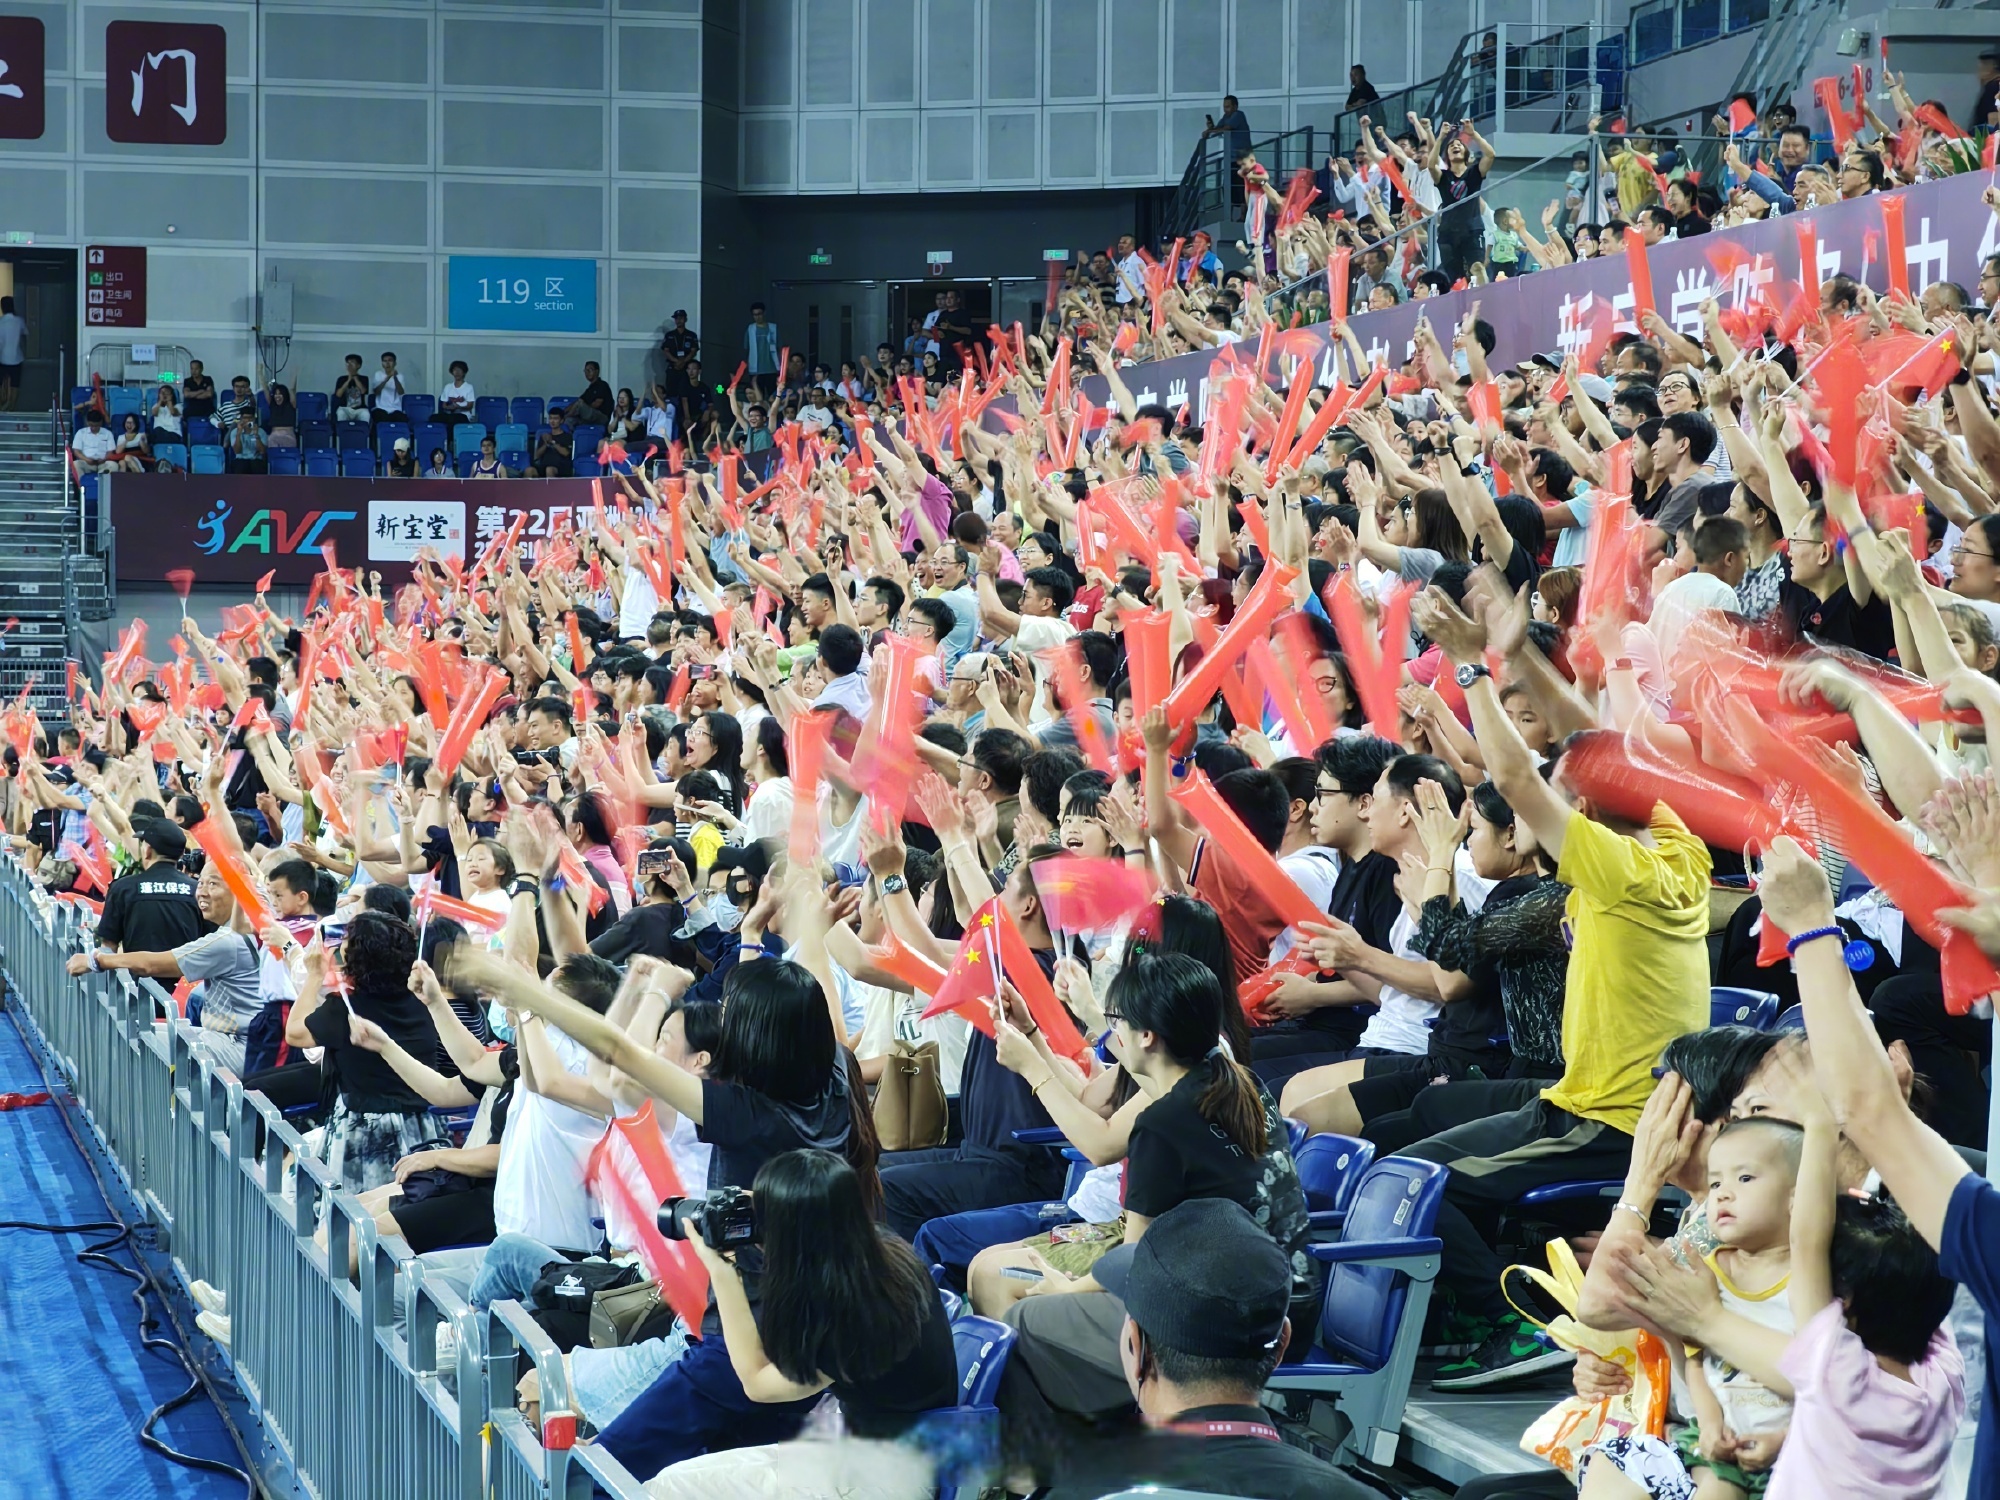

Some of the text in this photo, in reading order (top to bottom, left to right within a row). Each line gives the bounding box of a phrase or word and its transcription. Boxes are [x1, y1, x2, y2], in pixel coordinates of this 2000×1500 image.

[105, 271, 123, 281] 出口
[478, 277, 565, 304] 119 区
[534, 300, 574, 310] section
[227, 509, 358, 555] AVC
[375, 514, 449, 541] 新宝堂
